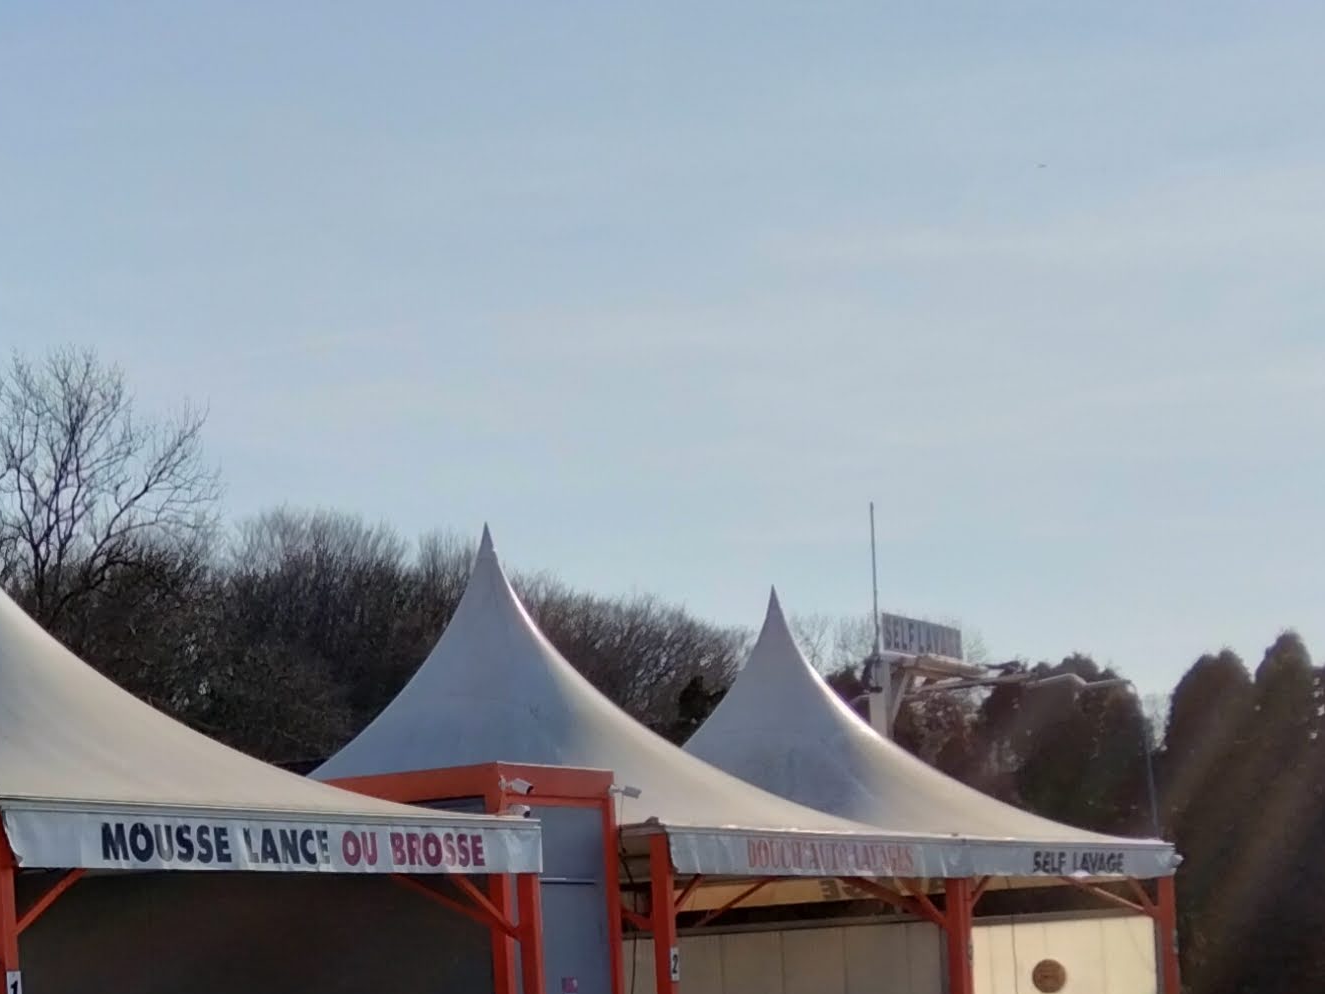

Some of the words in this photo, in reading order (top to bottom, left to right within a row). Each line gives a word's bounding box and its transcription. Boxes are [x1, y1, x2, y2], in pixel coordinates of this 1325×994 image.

[101, 822, 232, 863] MOUSSE
[241, 826, 330, 866] LANCE
[341, 830, 378, 867] OU
[390, 831, 486, 867] BROSSE
[1033, 850, 1067, 874] SELF
[1072, 851, 1124, 874] LAVAGE
[672, 953, 679, 974] 2
